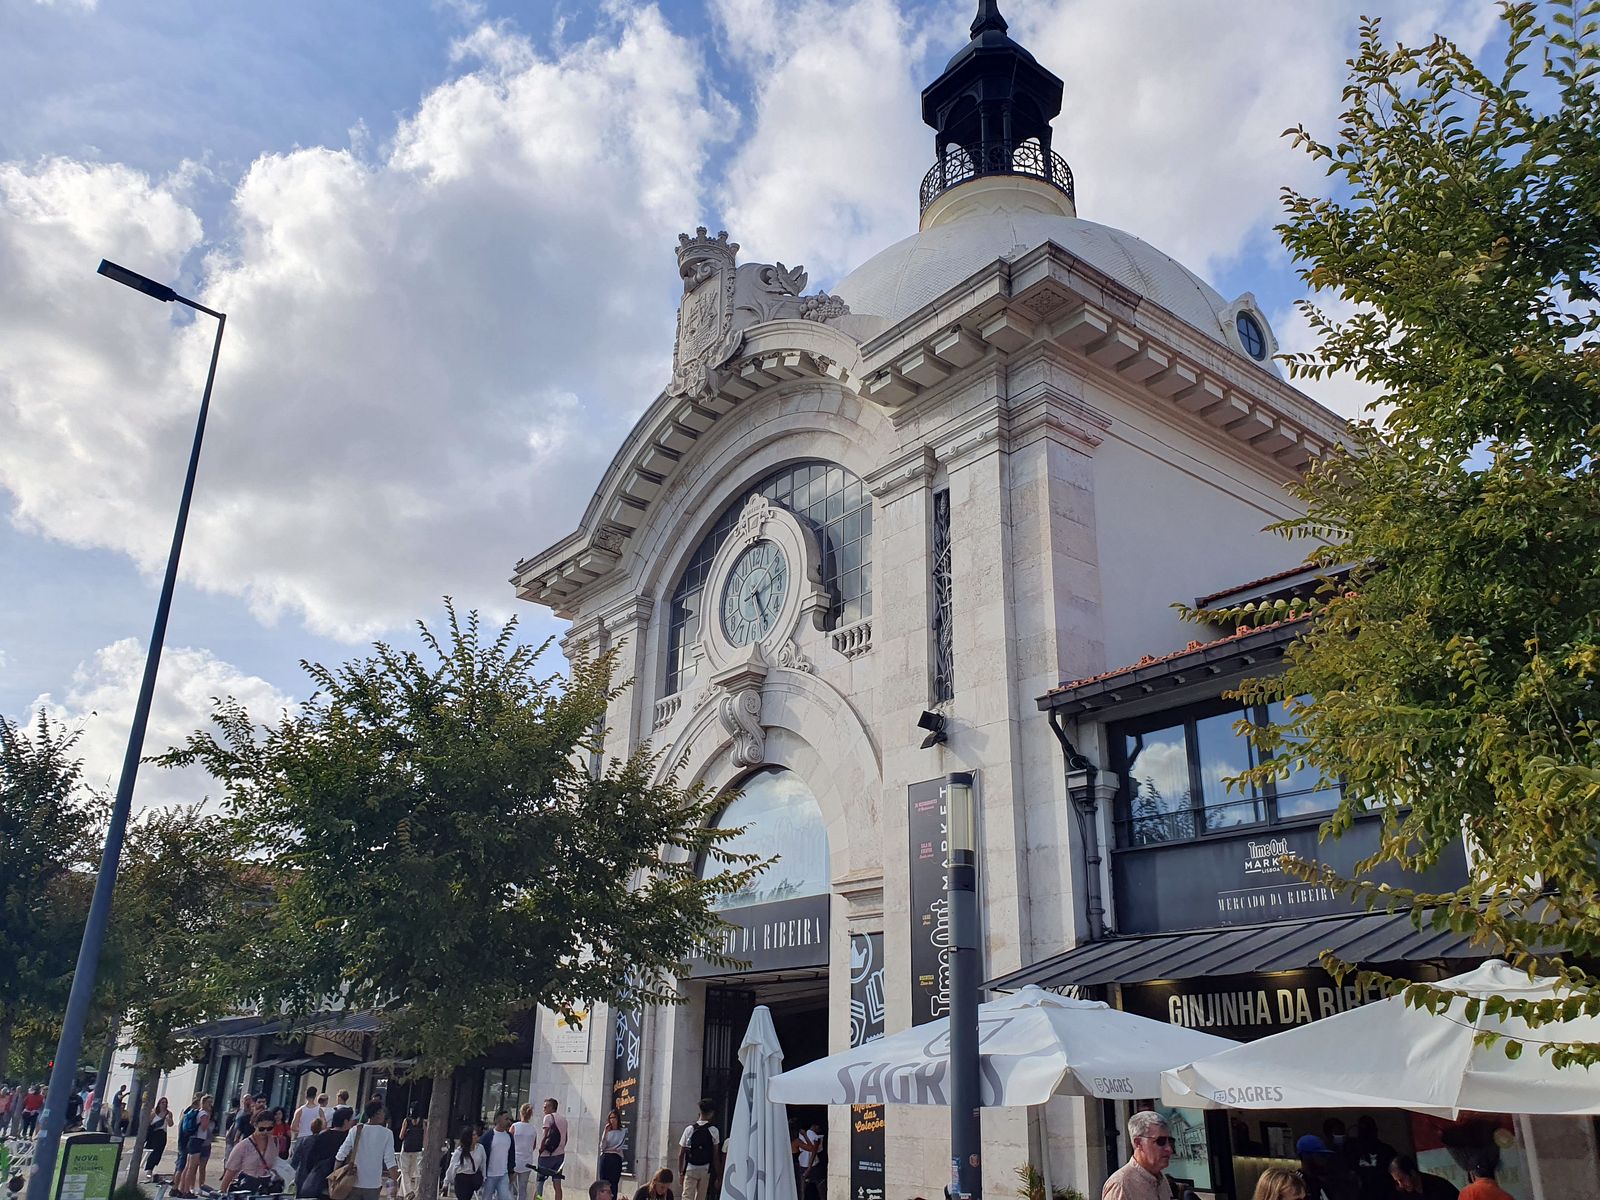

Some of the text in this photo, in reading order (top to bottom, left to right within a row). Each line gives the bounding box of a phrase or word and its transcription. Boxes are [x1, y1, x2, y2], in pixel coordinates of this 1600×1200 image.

[774, 556, 780, 572] 2
[777, 575, 782, 591] 3
[728, 597, 734, 613] 9
[773, 595, 779, 612] 4
[730, 616, 736, 632] 8
[751, 624, 757, 641] 6
[738, 624, 745, 643] 7
[1245, 855, 1297, 870] MARKT
[1261, 866, 1281, 874] LISBOA
[1218, 887, 1335, 911] MERCADO DA RIBEIRA
[742, 926, 756, 952] DA
[763, 917, 821, 950] RIBEIRA
[1168, 989, 1272, 1028] GINJINHA
[1277, 988, 1313, 1025] DA
[1103, 1077, 1134, 1094] SAGRES
[1227, 1086, 1284, 1104] SAGRES
